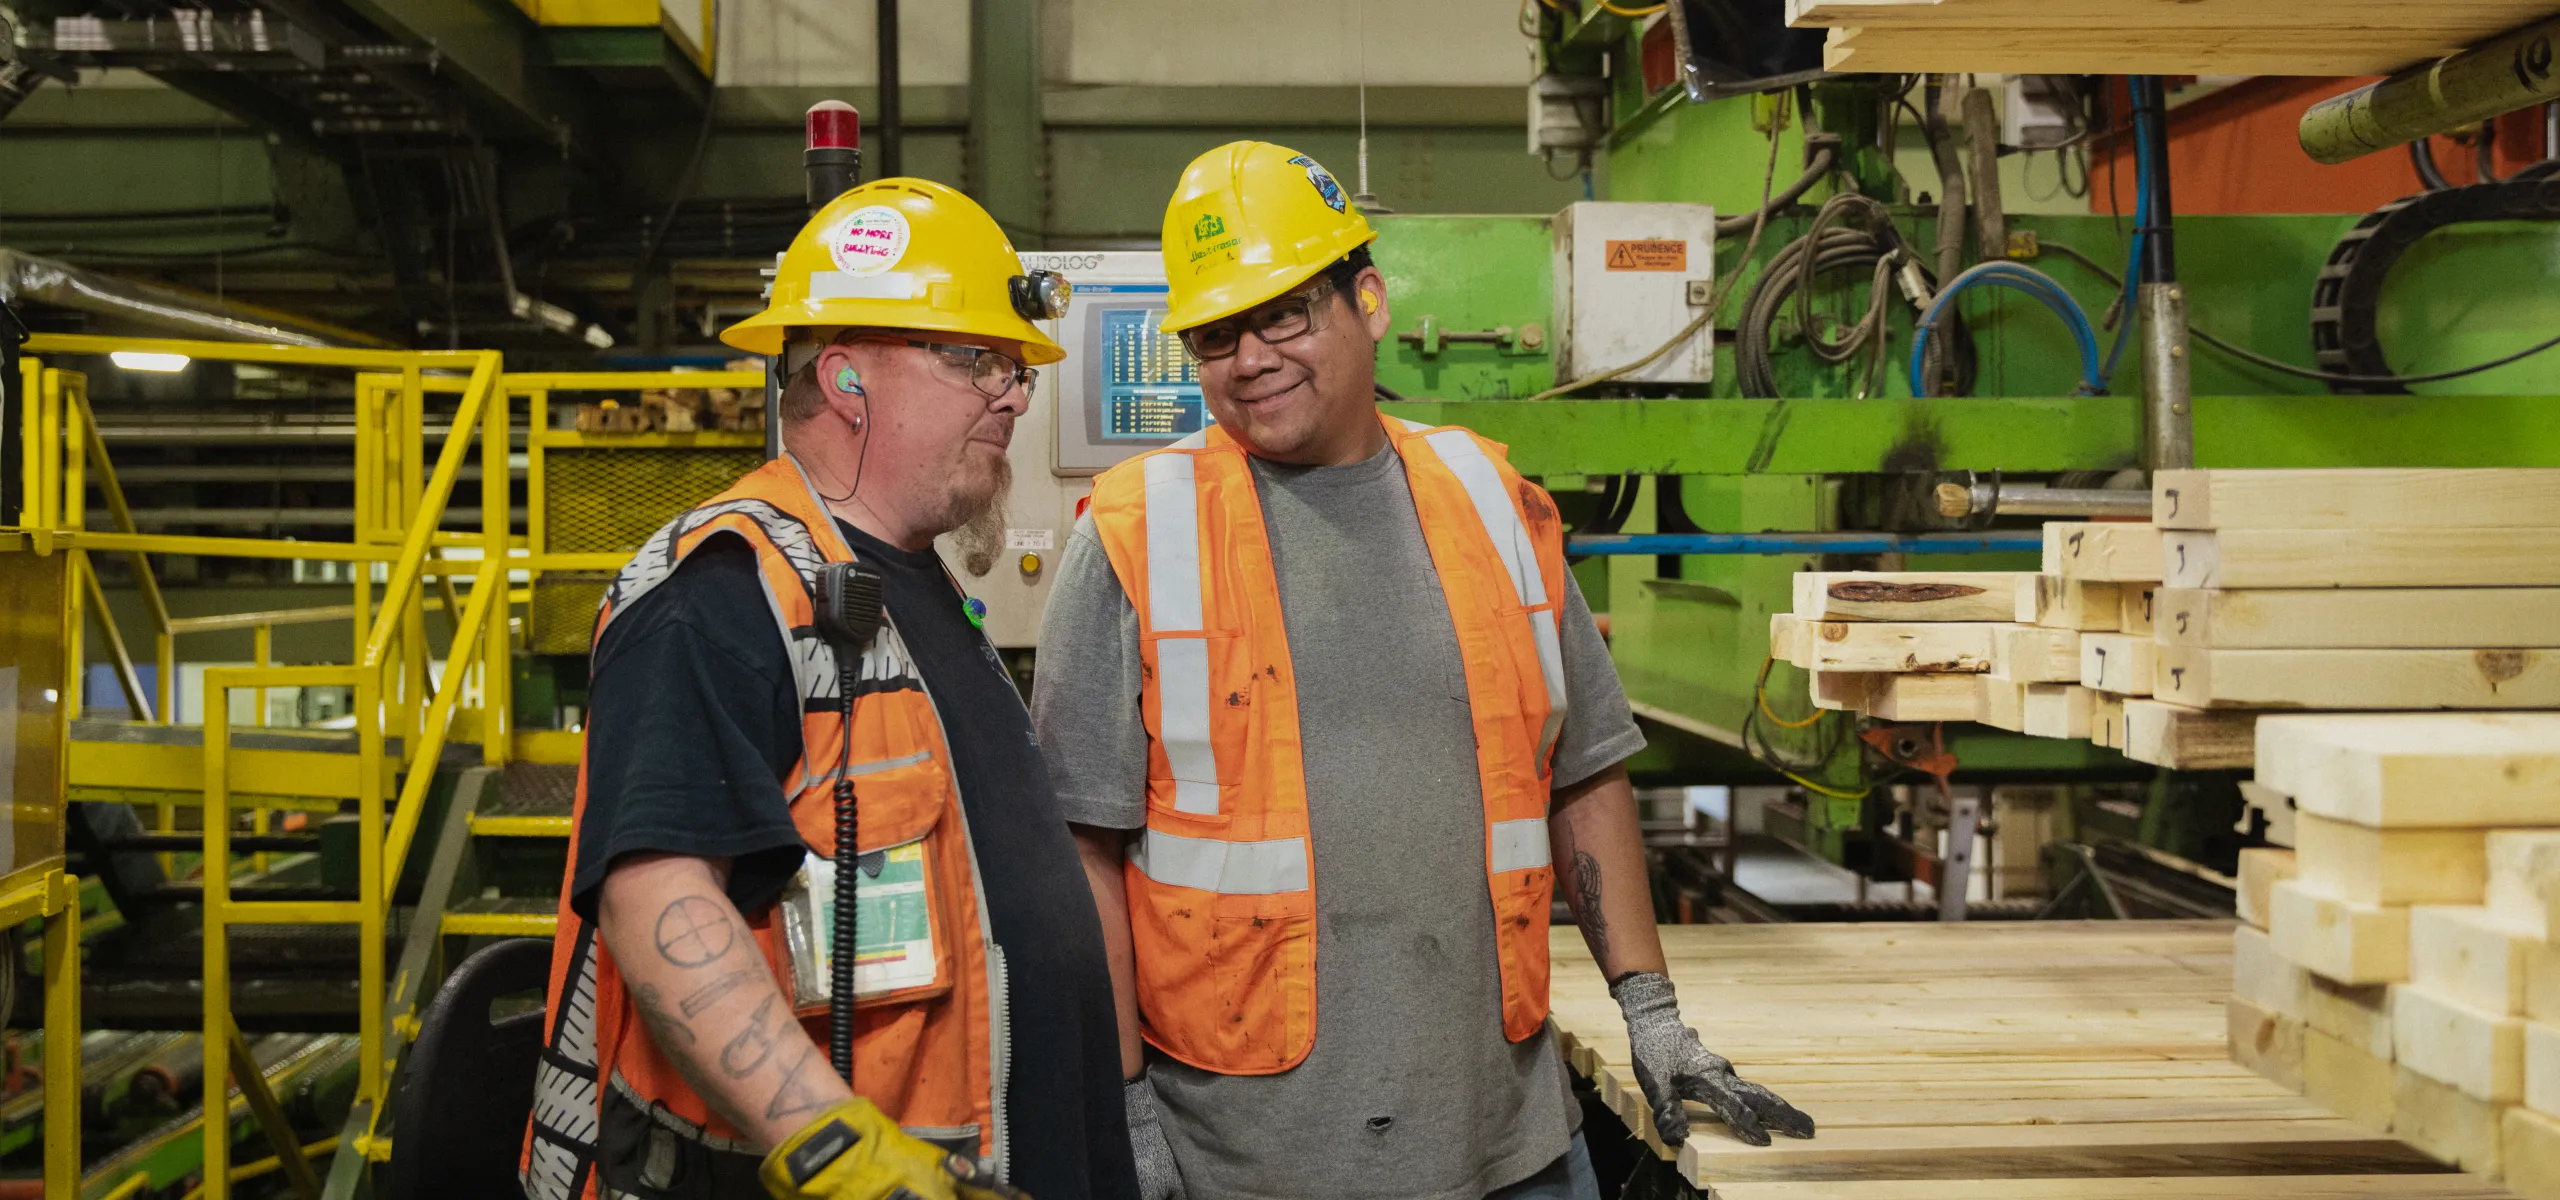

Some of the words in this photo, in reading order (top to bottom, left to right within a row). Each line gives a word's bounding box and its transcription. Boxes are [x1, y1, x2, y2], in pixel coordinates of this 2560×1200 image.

[850, 228, 864, 241] NO
[865, 229, 893, 240] MORE
[1630, 243, 1684, 254] PRUDENCE
